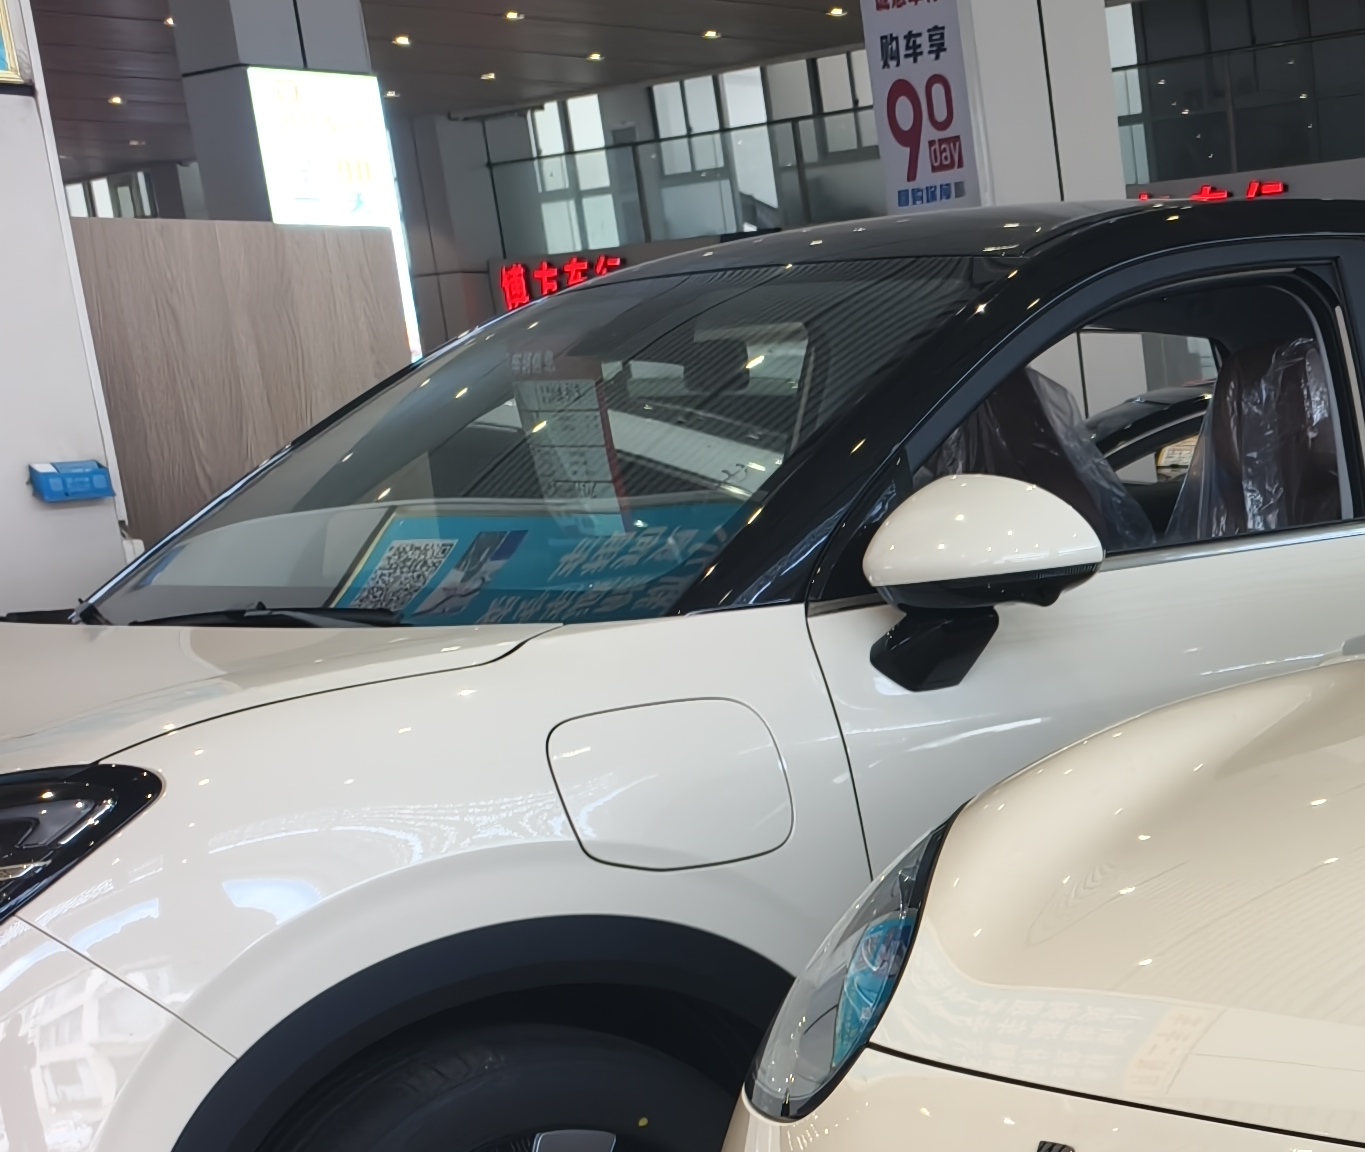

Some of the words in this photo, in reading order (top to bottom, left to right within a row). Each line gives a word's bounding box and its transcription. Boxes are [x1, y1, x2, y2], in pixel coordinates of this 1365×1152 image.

[880, 25, 947, 69] 购车享
[887, 74, 954, 182] 90
[930, 139, 961, 170] day
